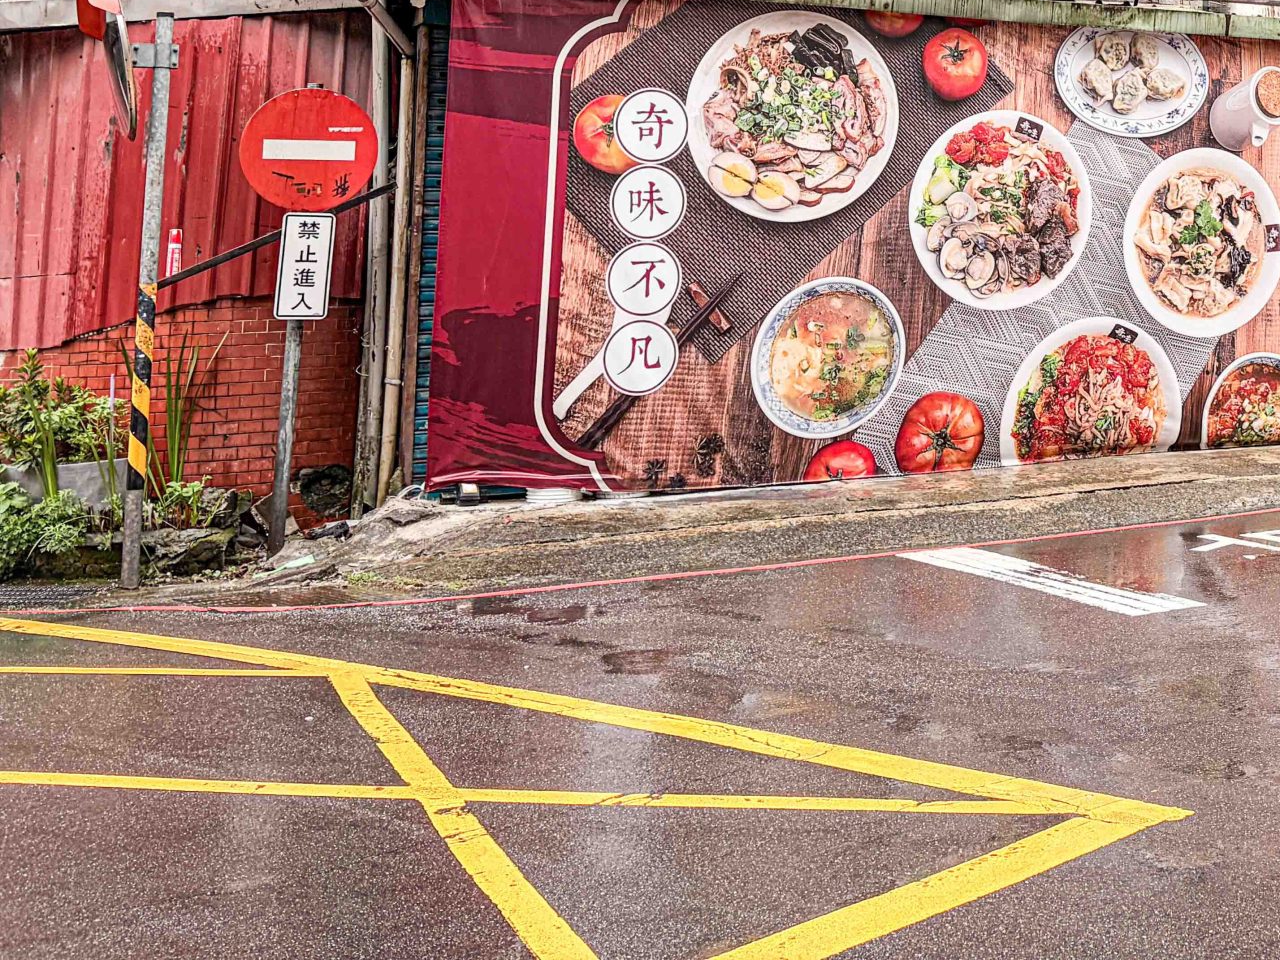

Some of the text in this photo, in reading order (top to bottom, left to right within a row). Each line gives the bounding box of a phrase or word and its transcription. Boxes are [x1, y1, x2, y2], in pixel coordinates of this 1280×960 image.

[291, 221, 321, 312] 禁止進入
[619, 103, 673, 375] 奇味不凡
